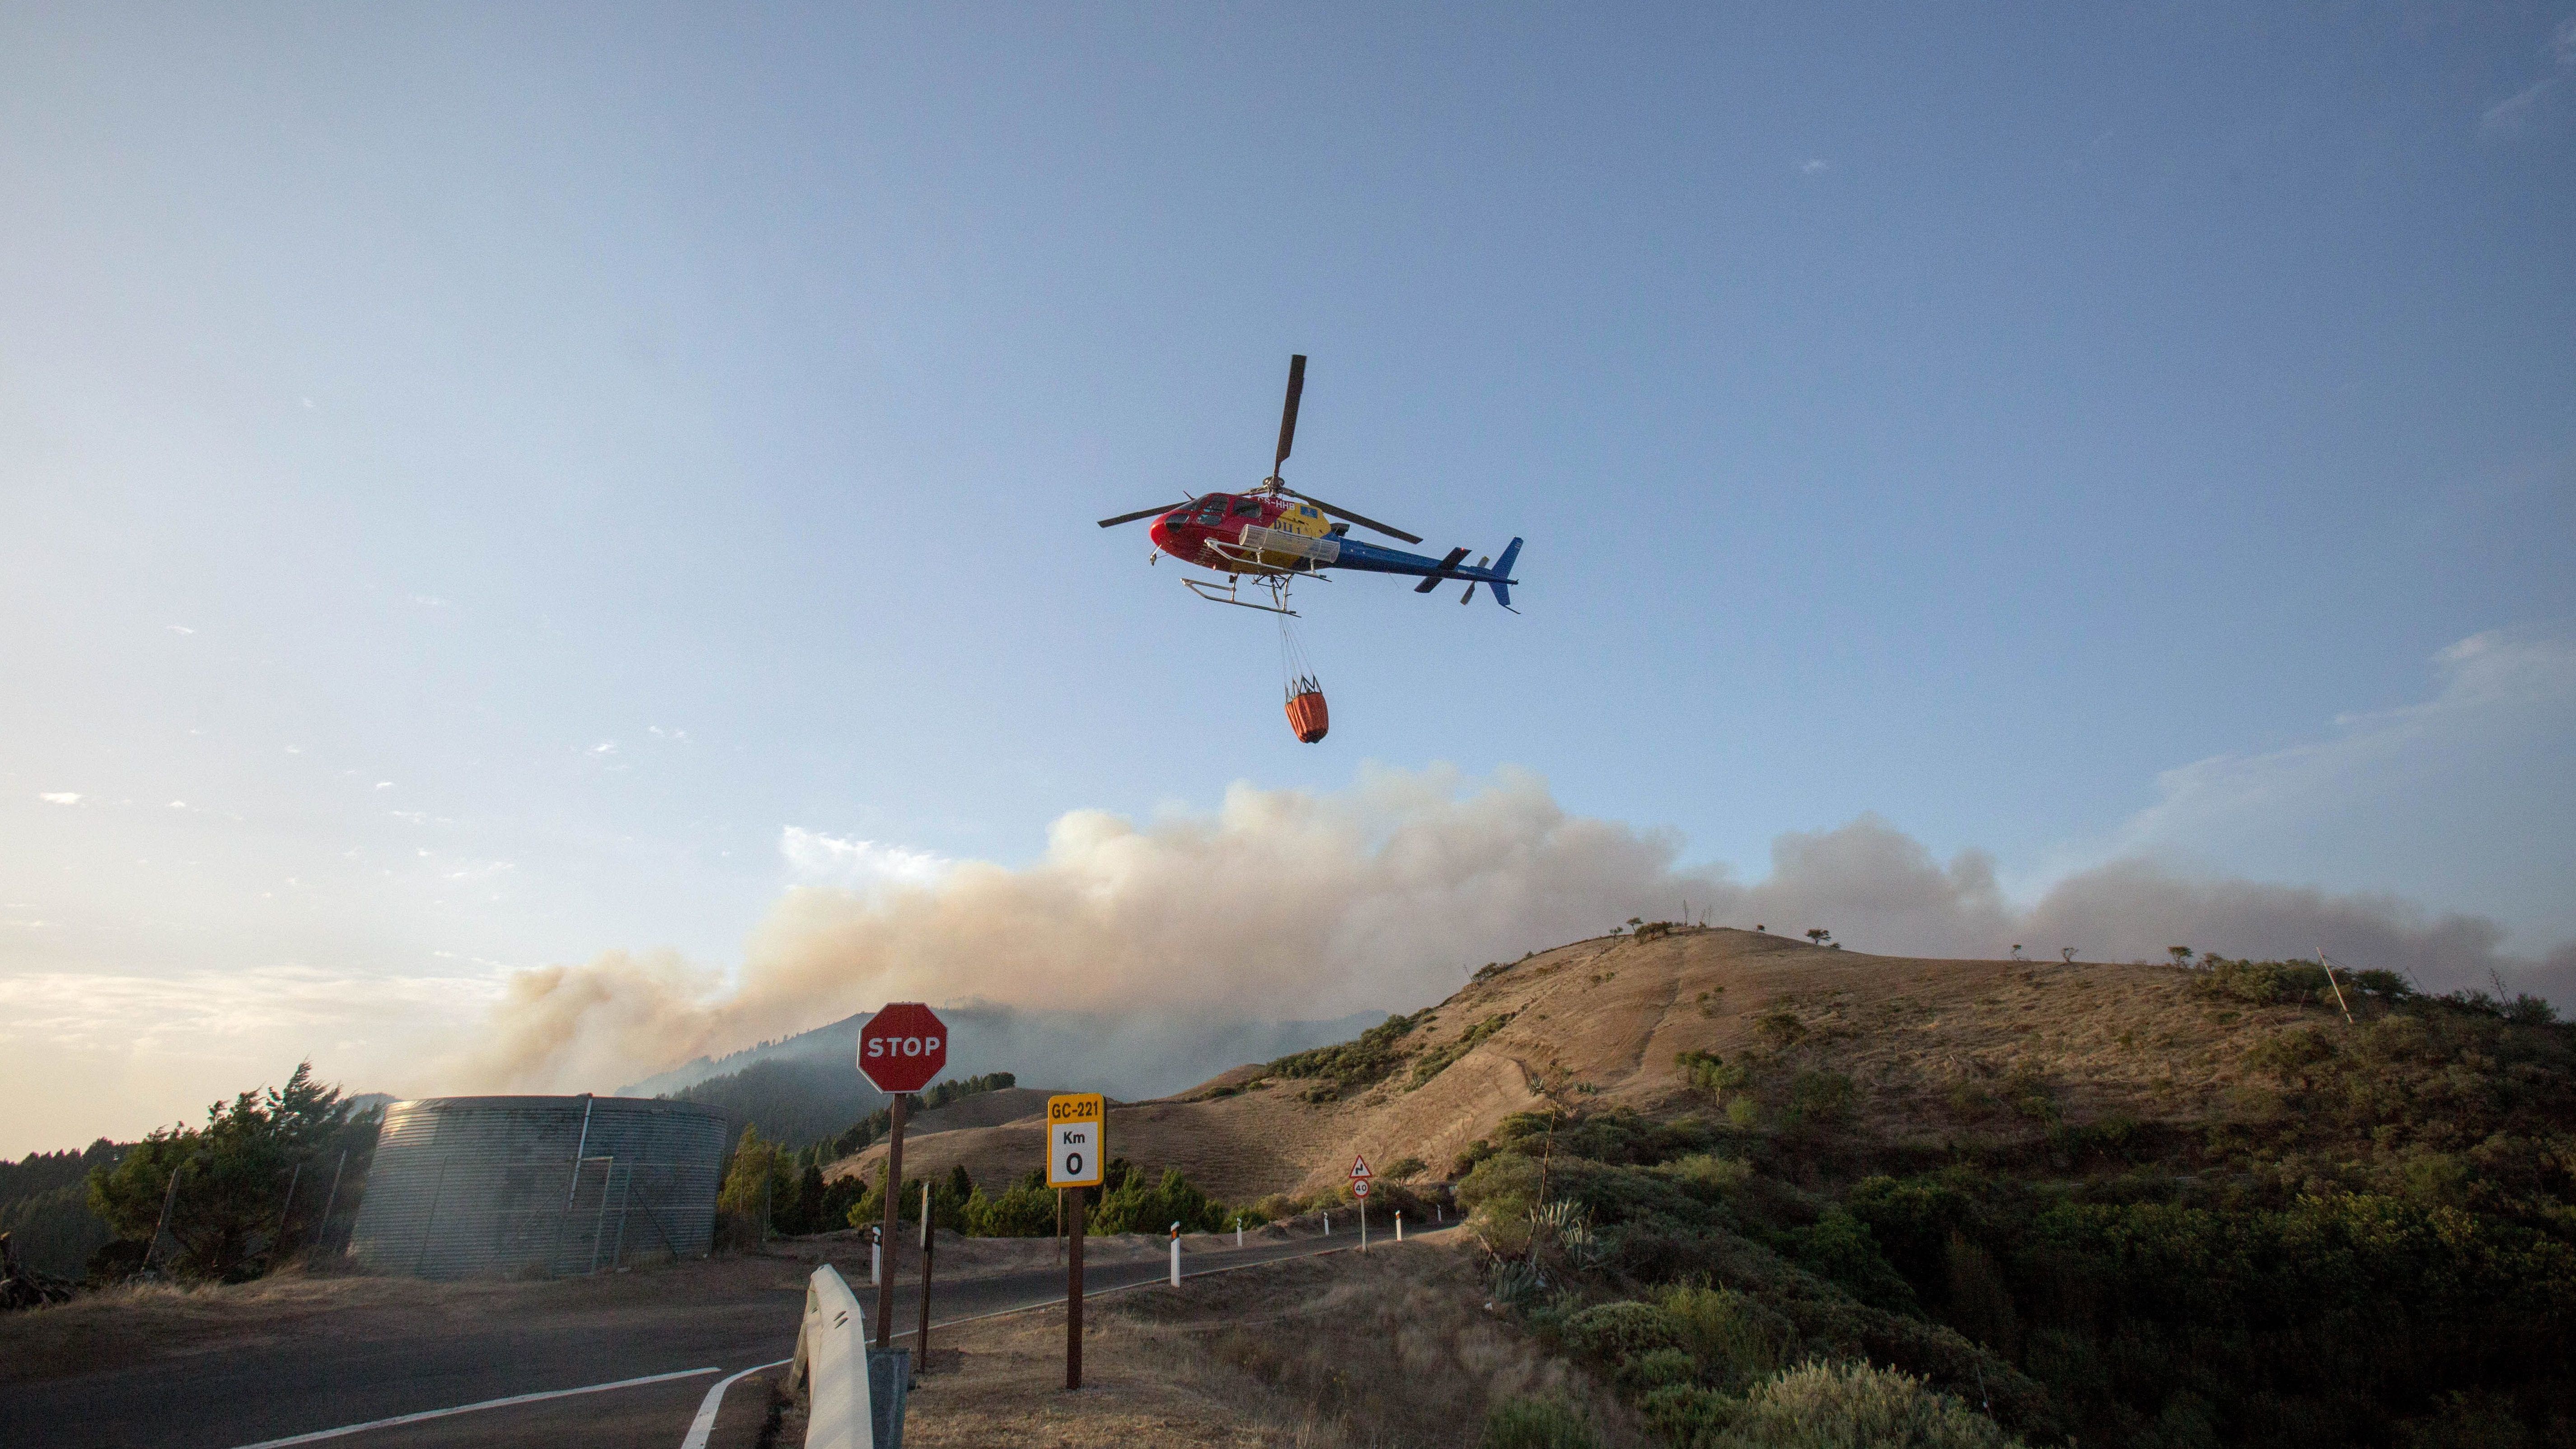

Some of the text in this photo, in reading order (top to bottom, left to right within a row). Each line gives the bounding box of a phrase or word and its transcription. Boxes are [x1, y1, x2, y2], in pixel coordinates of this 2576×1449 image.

[867, 1037, 940, 1057] STOP
[1052, 1101, 1098, 1119] GC-221
[1063, 1131, 1085, 1144] Km
[1066, 1152, 1083, 1175] 0
